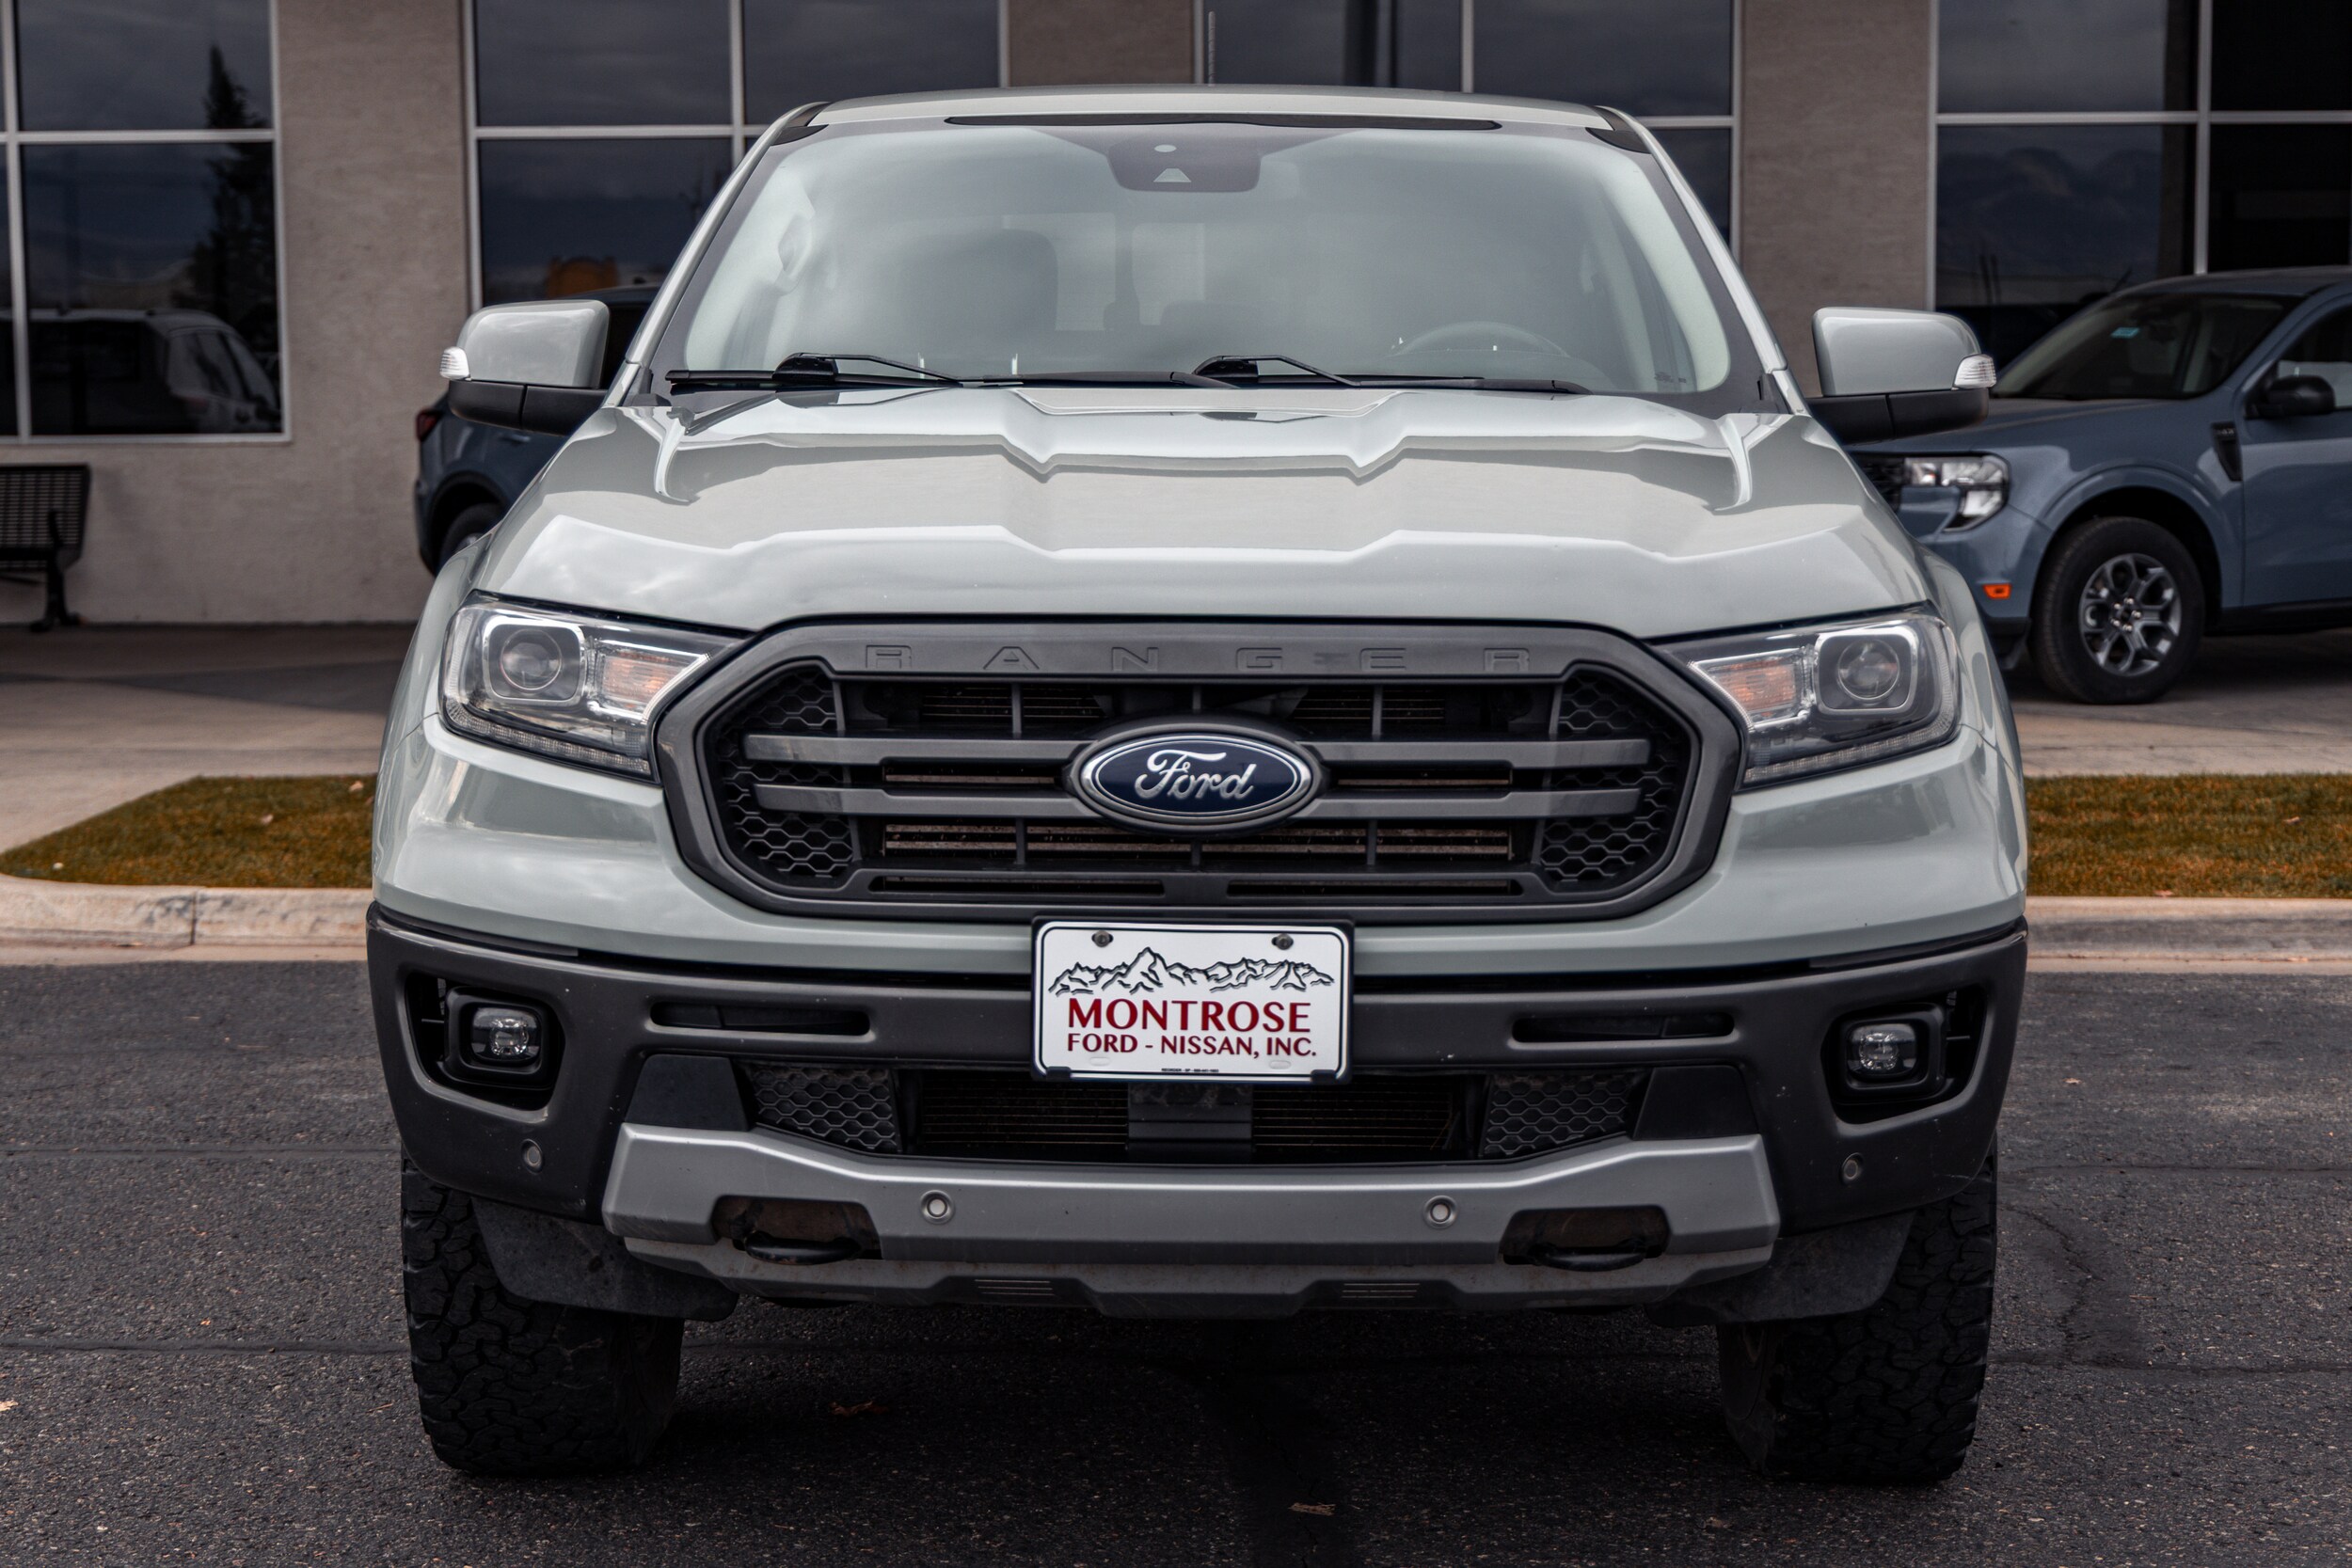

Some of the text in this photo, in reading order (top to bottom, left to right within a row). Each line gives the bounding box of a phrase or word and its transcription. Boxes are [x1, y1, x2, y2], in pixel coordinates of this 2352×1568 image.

[865, 644, 1531, 671] RANGER
[1135, 749, 1257, 800] Ford
[1068, 997, 1311, 1033] MONTROSE
[1067, 1033, 1138, 1053] FORD
[1160, 1035, 1260, 1059] NISSAN,
[1265, 1037, 1317, 1056] INC.
